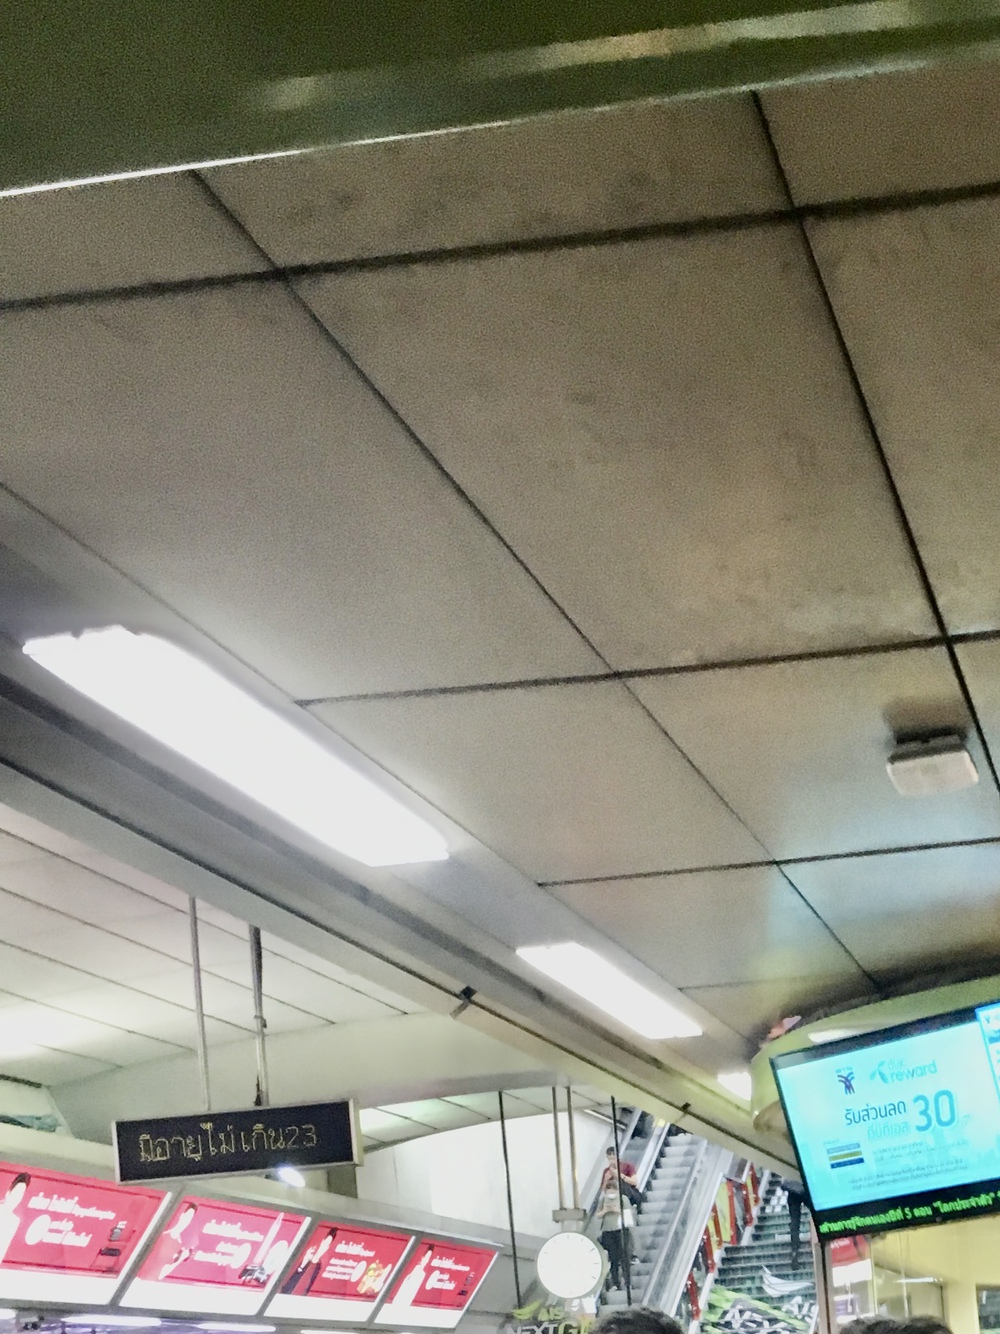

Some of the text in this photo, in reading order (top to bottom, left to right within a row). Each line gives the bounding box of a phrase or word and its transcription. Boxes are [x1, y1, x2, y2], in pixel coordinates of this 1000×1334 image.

[890, 1060, 938, 1083] reward
[844, 1089, 956, 1132] รับส่วนลด 30
